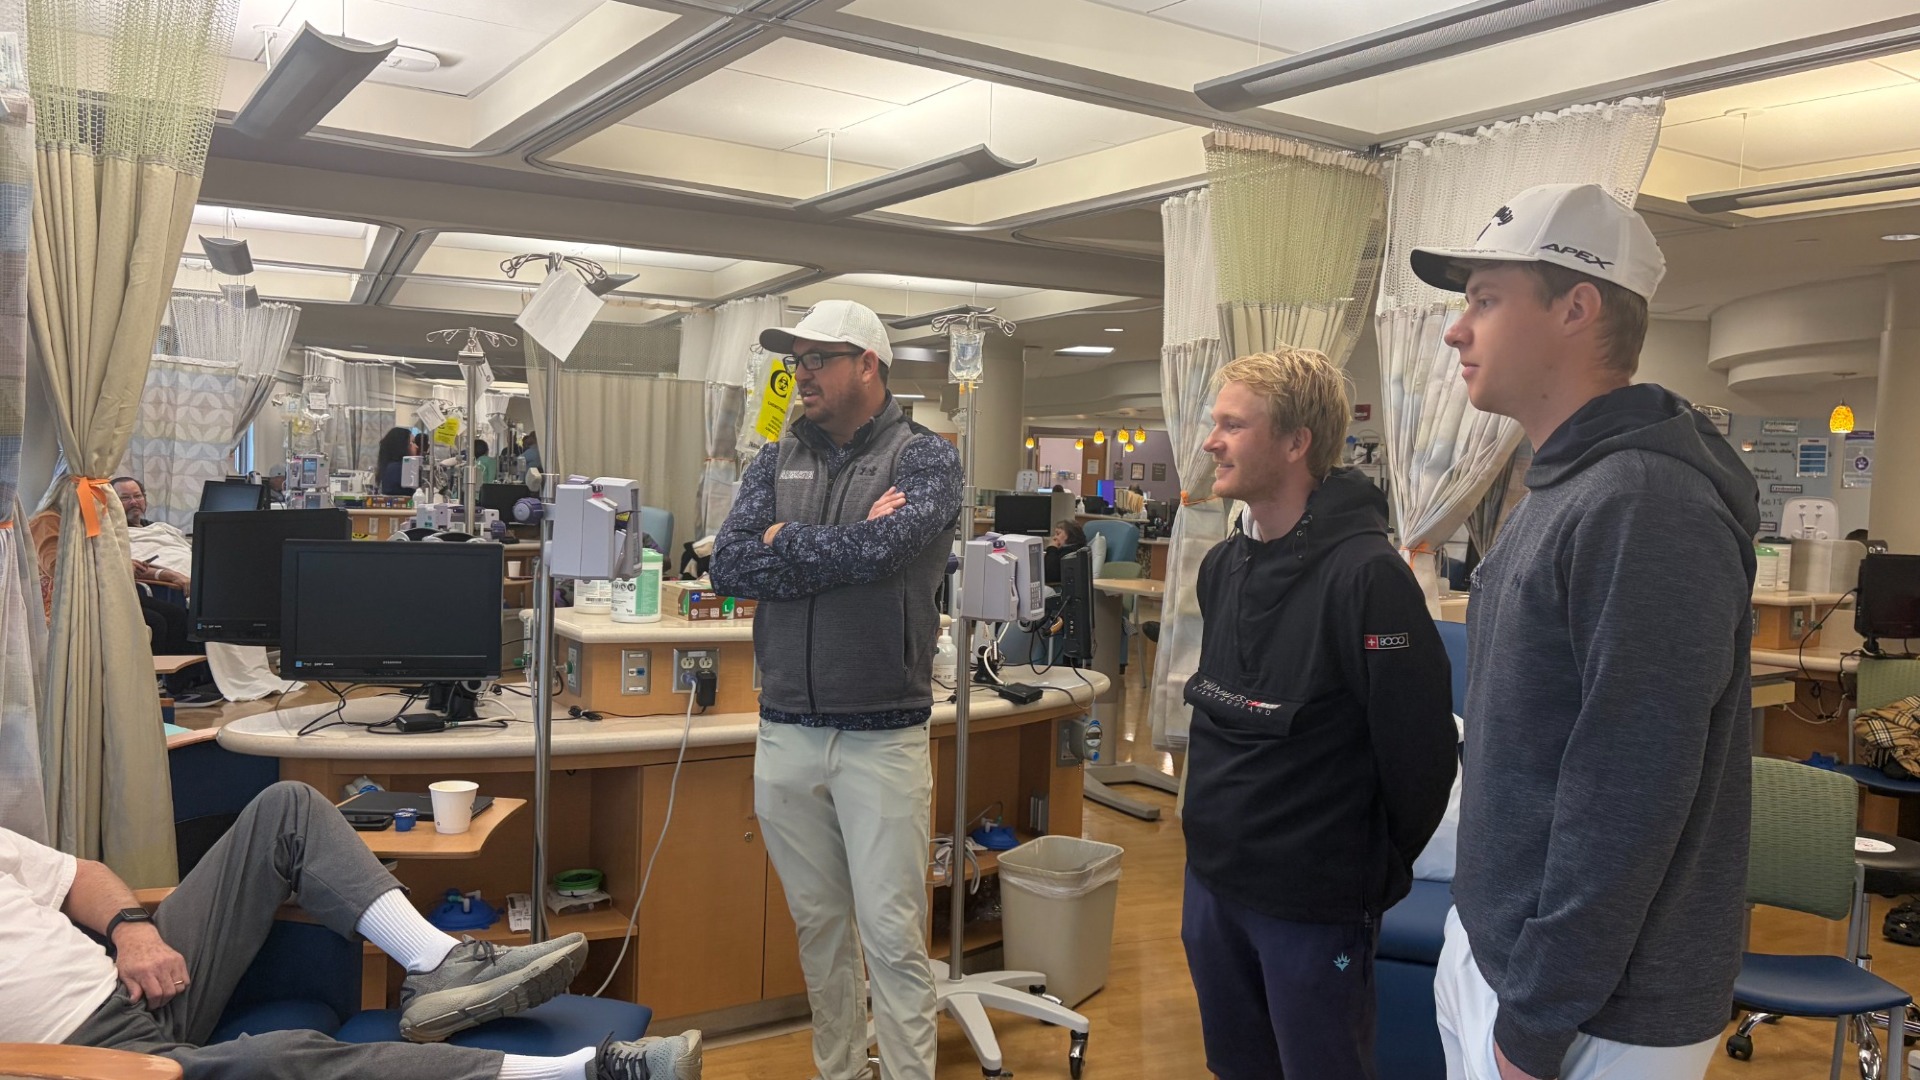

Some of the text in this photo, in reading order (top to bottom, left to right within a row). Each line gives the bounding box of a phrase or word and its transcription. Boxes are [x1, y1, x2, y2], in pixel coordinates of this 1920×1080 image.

[1540, 243, 1615, 270] APEX
[724, 604, 730, 612] L
[1380, 636, 1406, 646] 8000
